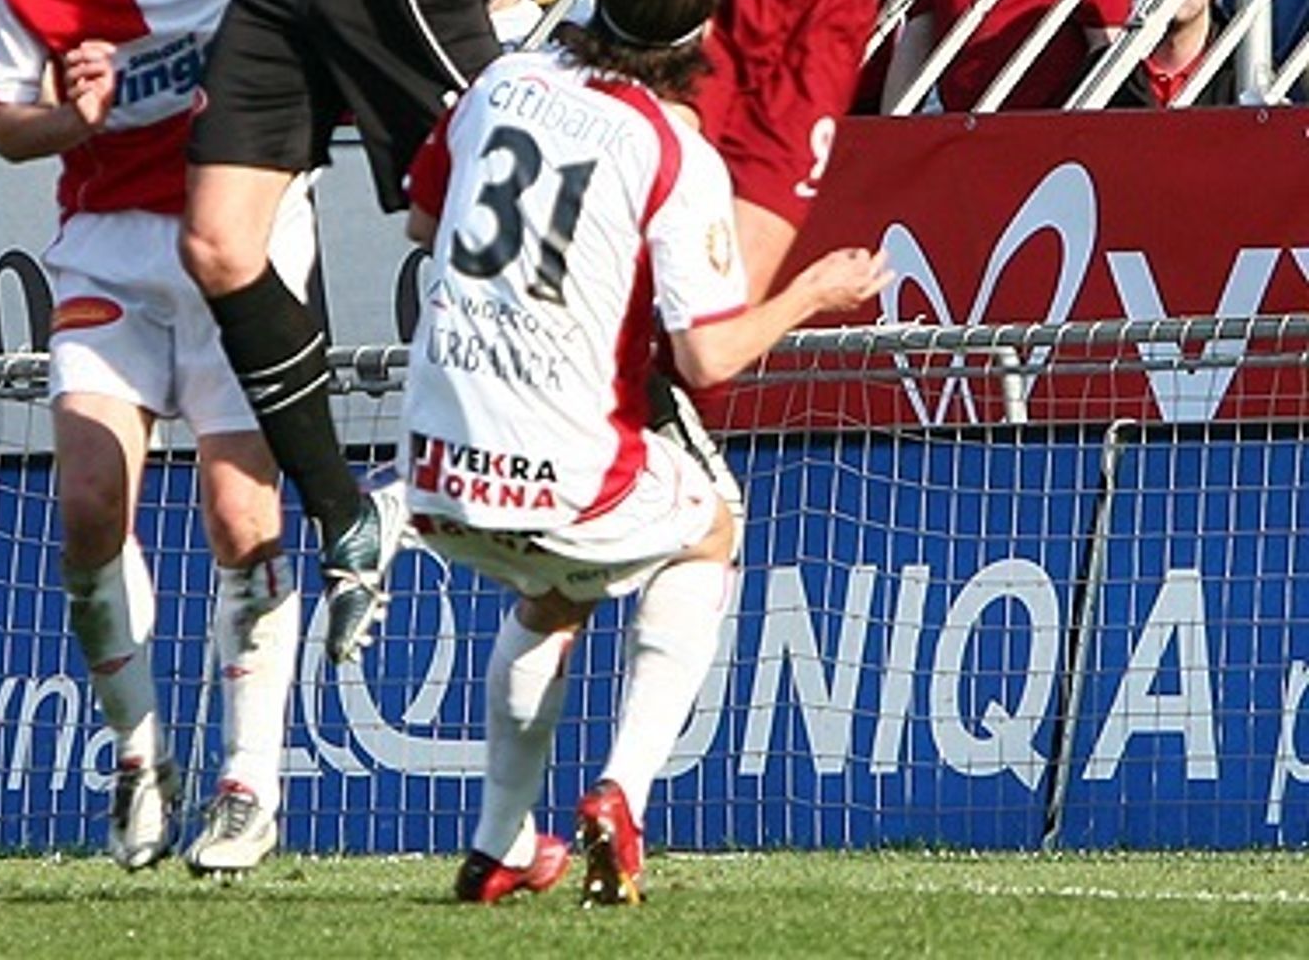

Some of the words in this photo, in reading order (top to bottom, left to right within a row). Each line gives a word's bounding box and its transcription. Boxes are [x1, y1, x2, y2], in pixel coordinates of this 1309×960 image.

[113, 47, 207, 108] ing
[450, 125, 598, 308] 31
[448, 442, 558, 482] VEKRA
[444, 474, 556, 509] OKNA
